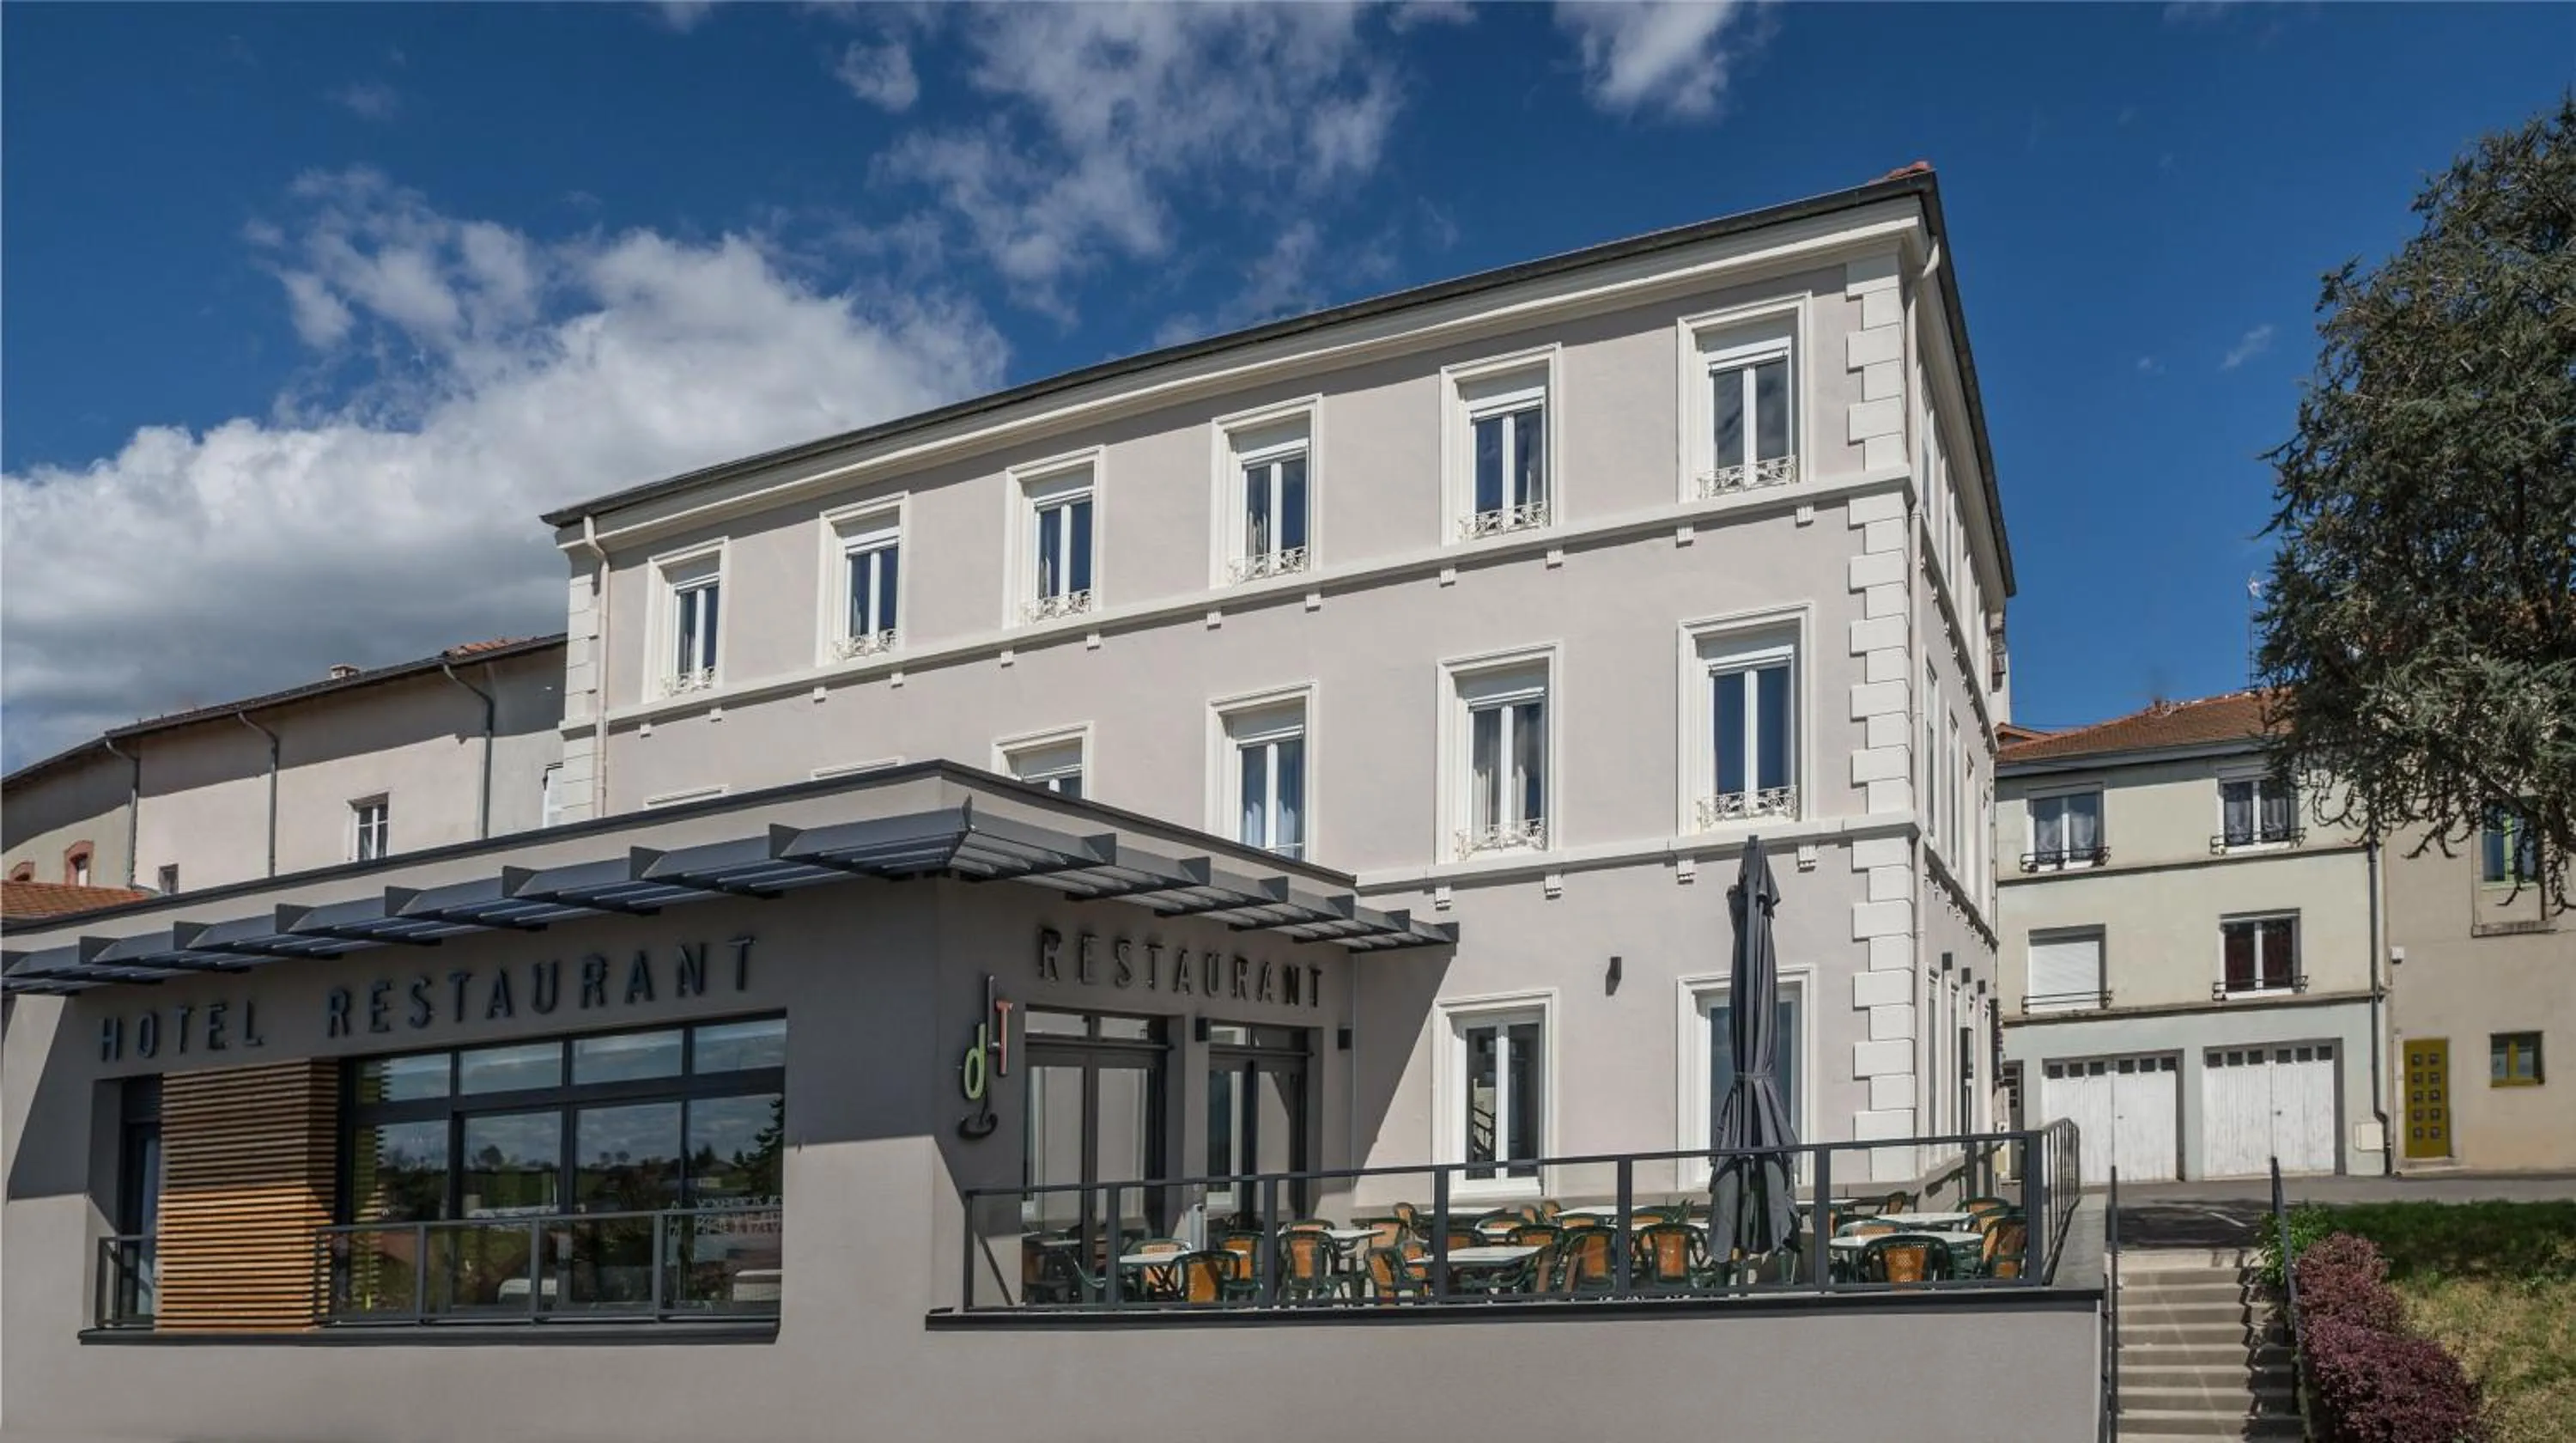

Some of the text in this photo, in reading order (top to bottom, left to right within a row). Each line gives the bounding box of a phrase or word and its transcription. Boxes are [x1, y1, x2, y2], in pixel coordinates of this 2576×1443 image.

[100, 935, 756, 1062] HOTEL RESTAURANT
[1038, 927, 1322, 1008] RESTAURANT
